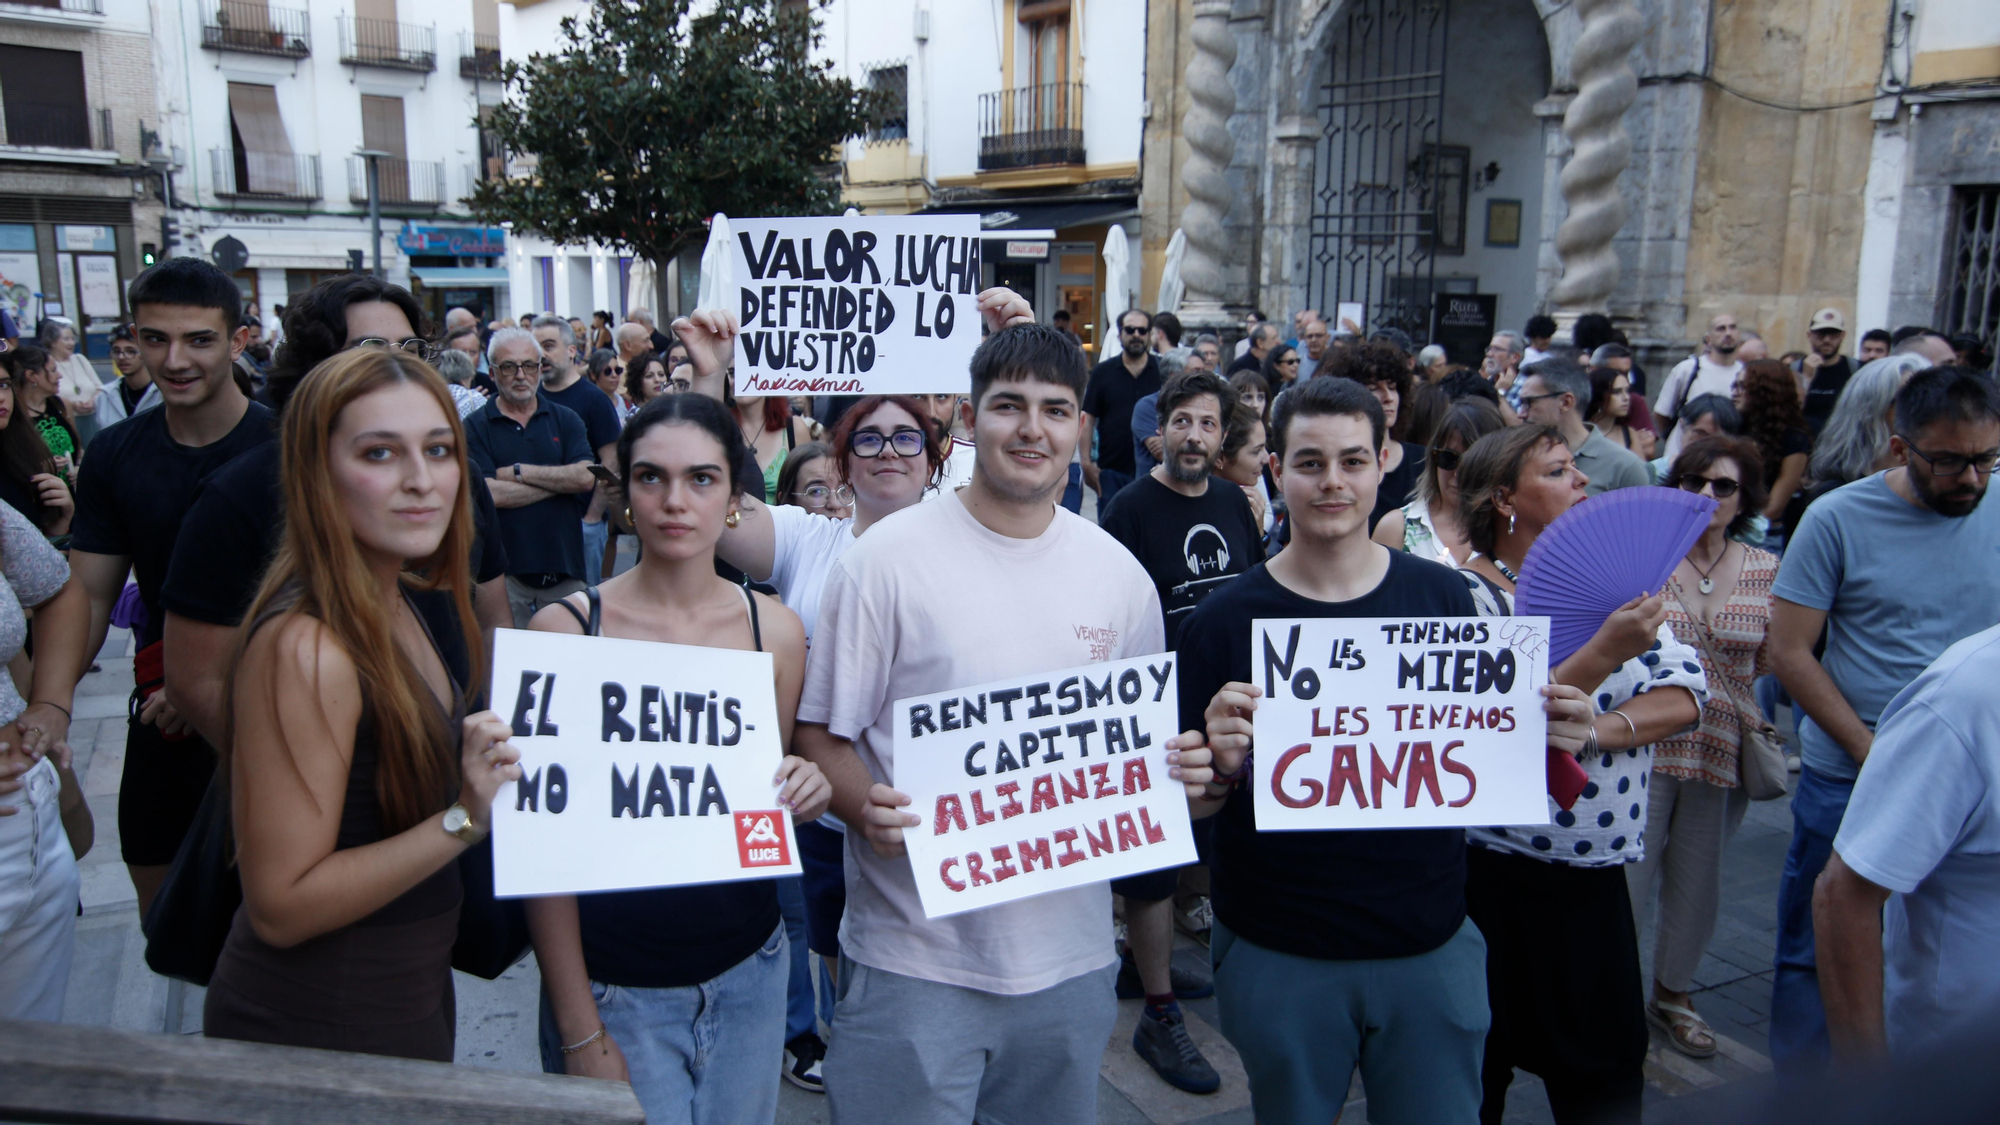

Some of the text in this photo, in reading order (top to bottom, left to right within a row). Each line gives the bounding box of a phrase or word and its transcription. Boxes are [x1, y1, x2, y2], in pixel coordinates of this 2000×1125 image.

[894, 234, 981, 295] LUCHA
[1009, 242, 1047, 255] Cruzcampo
[740, 285, 954, 339] DEFENDED LO
[1449, 299, 1479, 312] Ruta
[1329, 638, 1366, 670] LES
[1381, 621, 1489, 644] TENEMOS
[1398, 648, 1515, 694] MIEDO
[511, 670, 558, 737] EL
[1312, 704, 1515, 737] LES TENEMOS
[964, 715, 1152, 777] CAPITAL
[517, 762, 730, 819] NO MATA
[934, 756, 1152, 836] ALIANZA
[1271, 740, 1476, 809] GANAS
[749, 848, 780, 862] UJCE
[939, 805, 1166, 892] CRIMINAL
